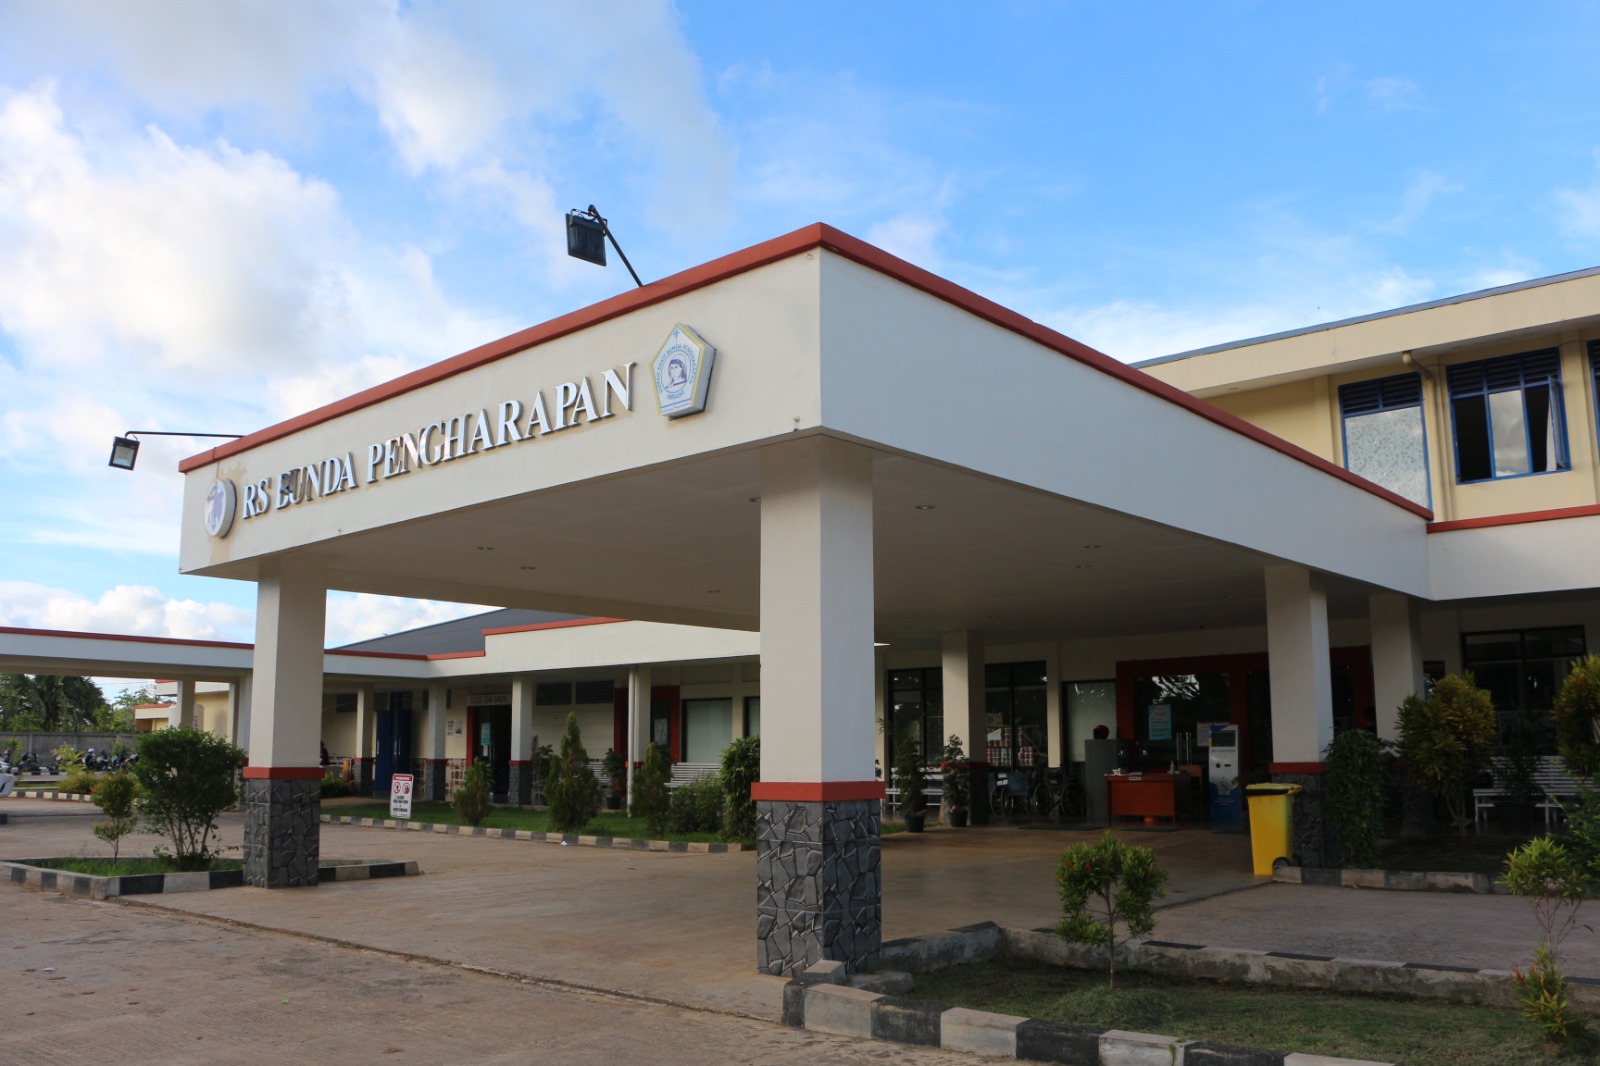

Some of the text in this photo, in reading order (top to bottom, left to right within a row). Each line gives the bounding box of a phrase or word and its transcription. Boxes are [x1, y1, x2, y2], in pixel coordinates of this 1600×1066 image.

[242, 477, 272, 519] RS
[366, 361, 637, 484] PENGHARAPAN
[484, 695, 492, 704] 24
